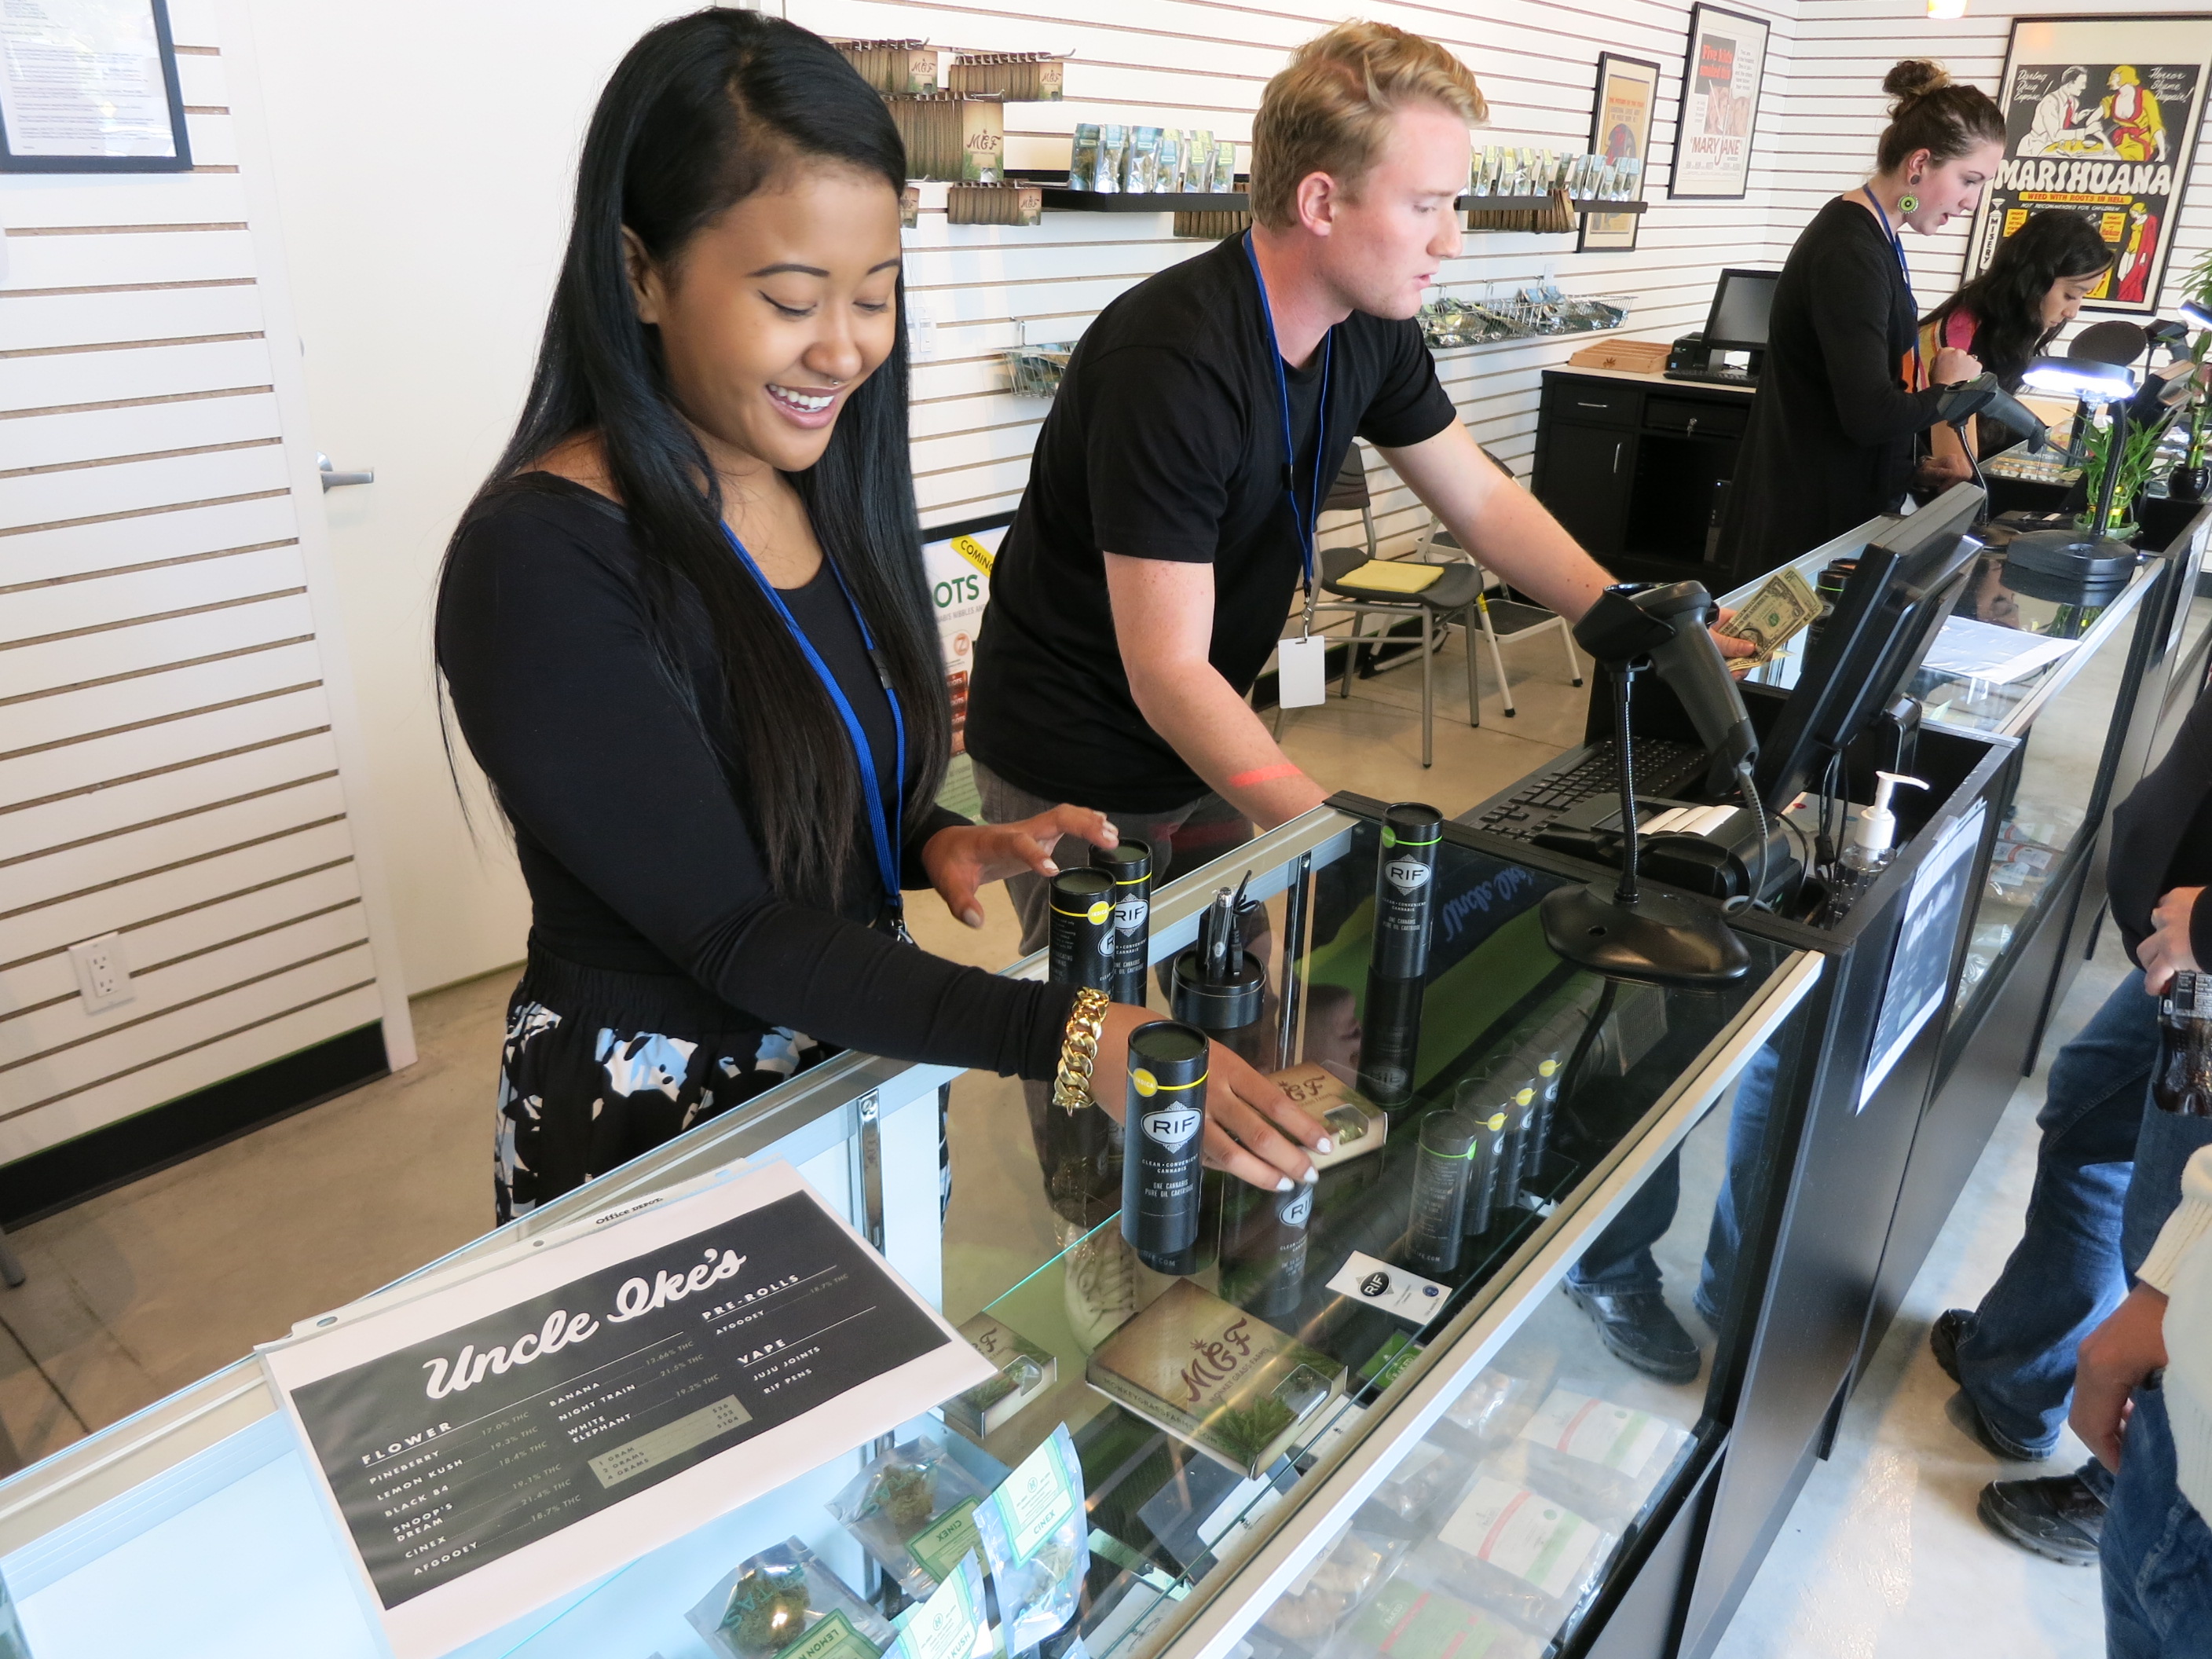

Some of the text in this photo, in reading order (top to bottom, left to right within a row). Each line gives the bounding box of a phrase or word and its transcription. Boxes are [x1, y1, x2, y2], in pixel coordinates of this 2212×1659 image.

[1994, 159, 2171, 196] MARIHUANA
[1983, 217, 1999, 265] MISERY
[934, 573, 980, 609] OTS
[953, 607, 975, 621] NIBBLES
[1391, 866, 1423, 881] RIF
[1091, 909, 1108, 917] INDICA
[1115, 905, 1144, 922] RIF
[1135, 1076, 1154, 1090] INDICA
[1153, 1115, 1196, 1134] RIF
[1141, 1159, 1161, 1167] CLEAN
[1144, 1188, 1157, 1197] PURE
[1166, 1178, 1188, 1189] CANNABIS
[595, 1209, 630, 1224] Office
[701, 1274, 800, 1320] PRE-ROLLS
[1364, 1273, 1384, 1295] RIF
[716, 1309, 765, 1335] AFGOOEY
[833, 1273, 849, 1284] THC
[422, 1309, 601, 1400] Uncle
[737, 1339, 786, 1364] VAPE
[753, 1346, 821, 1382] JUJU JOINTS
[549, 1340, 694, 1407] BANANA 12.66% THC
[764, 1368, 813, 1394] RIF PENS
[1209, 1346, 1270, 1403] MONKEY GRASS FARMS
[558, 1353, 705, 1422] NIGHT TRAIN 21.5% THC
[572, 1373, 720, 1444] ELEPHANT 19.2% THC
[567, 1415, 606, 1437] WHITE
[361, 1421, 453, 1465] FLOWER
[369, 1412, 529, 1485] PINEBERRY 17.0% THC
[607, 1447, 635, 1463] GRAM
[377, 1477, 423, 1501] LEMON
[428, 1458, 464, 1478] KUSH
[520, 1426, 539, 1438] THC
[612, 1452, 645, 1469] GRAMS
[617, 1458, 650, 1476] GRAMS
[385, 1441, 548, 1518] BLACK 84 18.4% THC
[397, 1463, 562, 1543] DREAM 19.1% THC
[393, 1503, 454, 1534] SNOOP'S
[405, 1478, 572, 1559] CINEX 21.4% THC
[936, 1519, 962, 1542] CINEX
[1033, 1509, 1056, 1535] CINEX
[413, 1494, 581, 1575] AFGOOEY 18.7% THC
[807, 1628, 839, 1656] LEMON
[951, 1632, 971, 1659] KUSH
